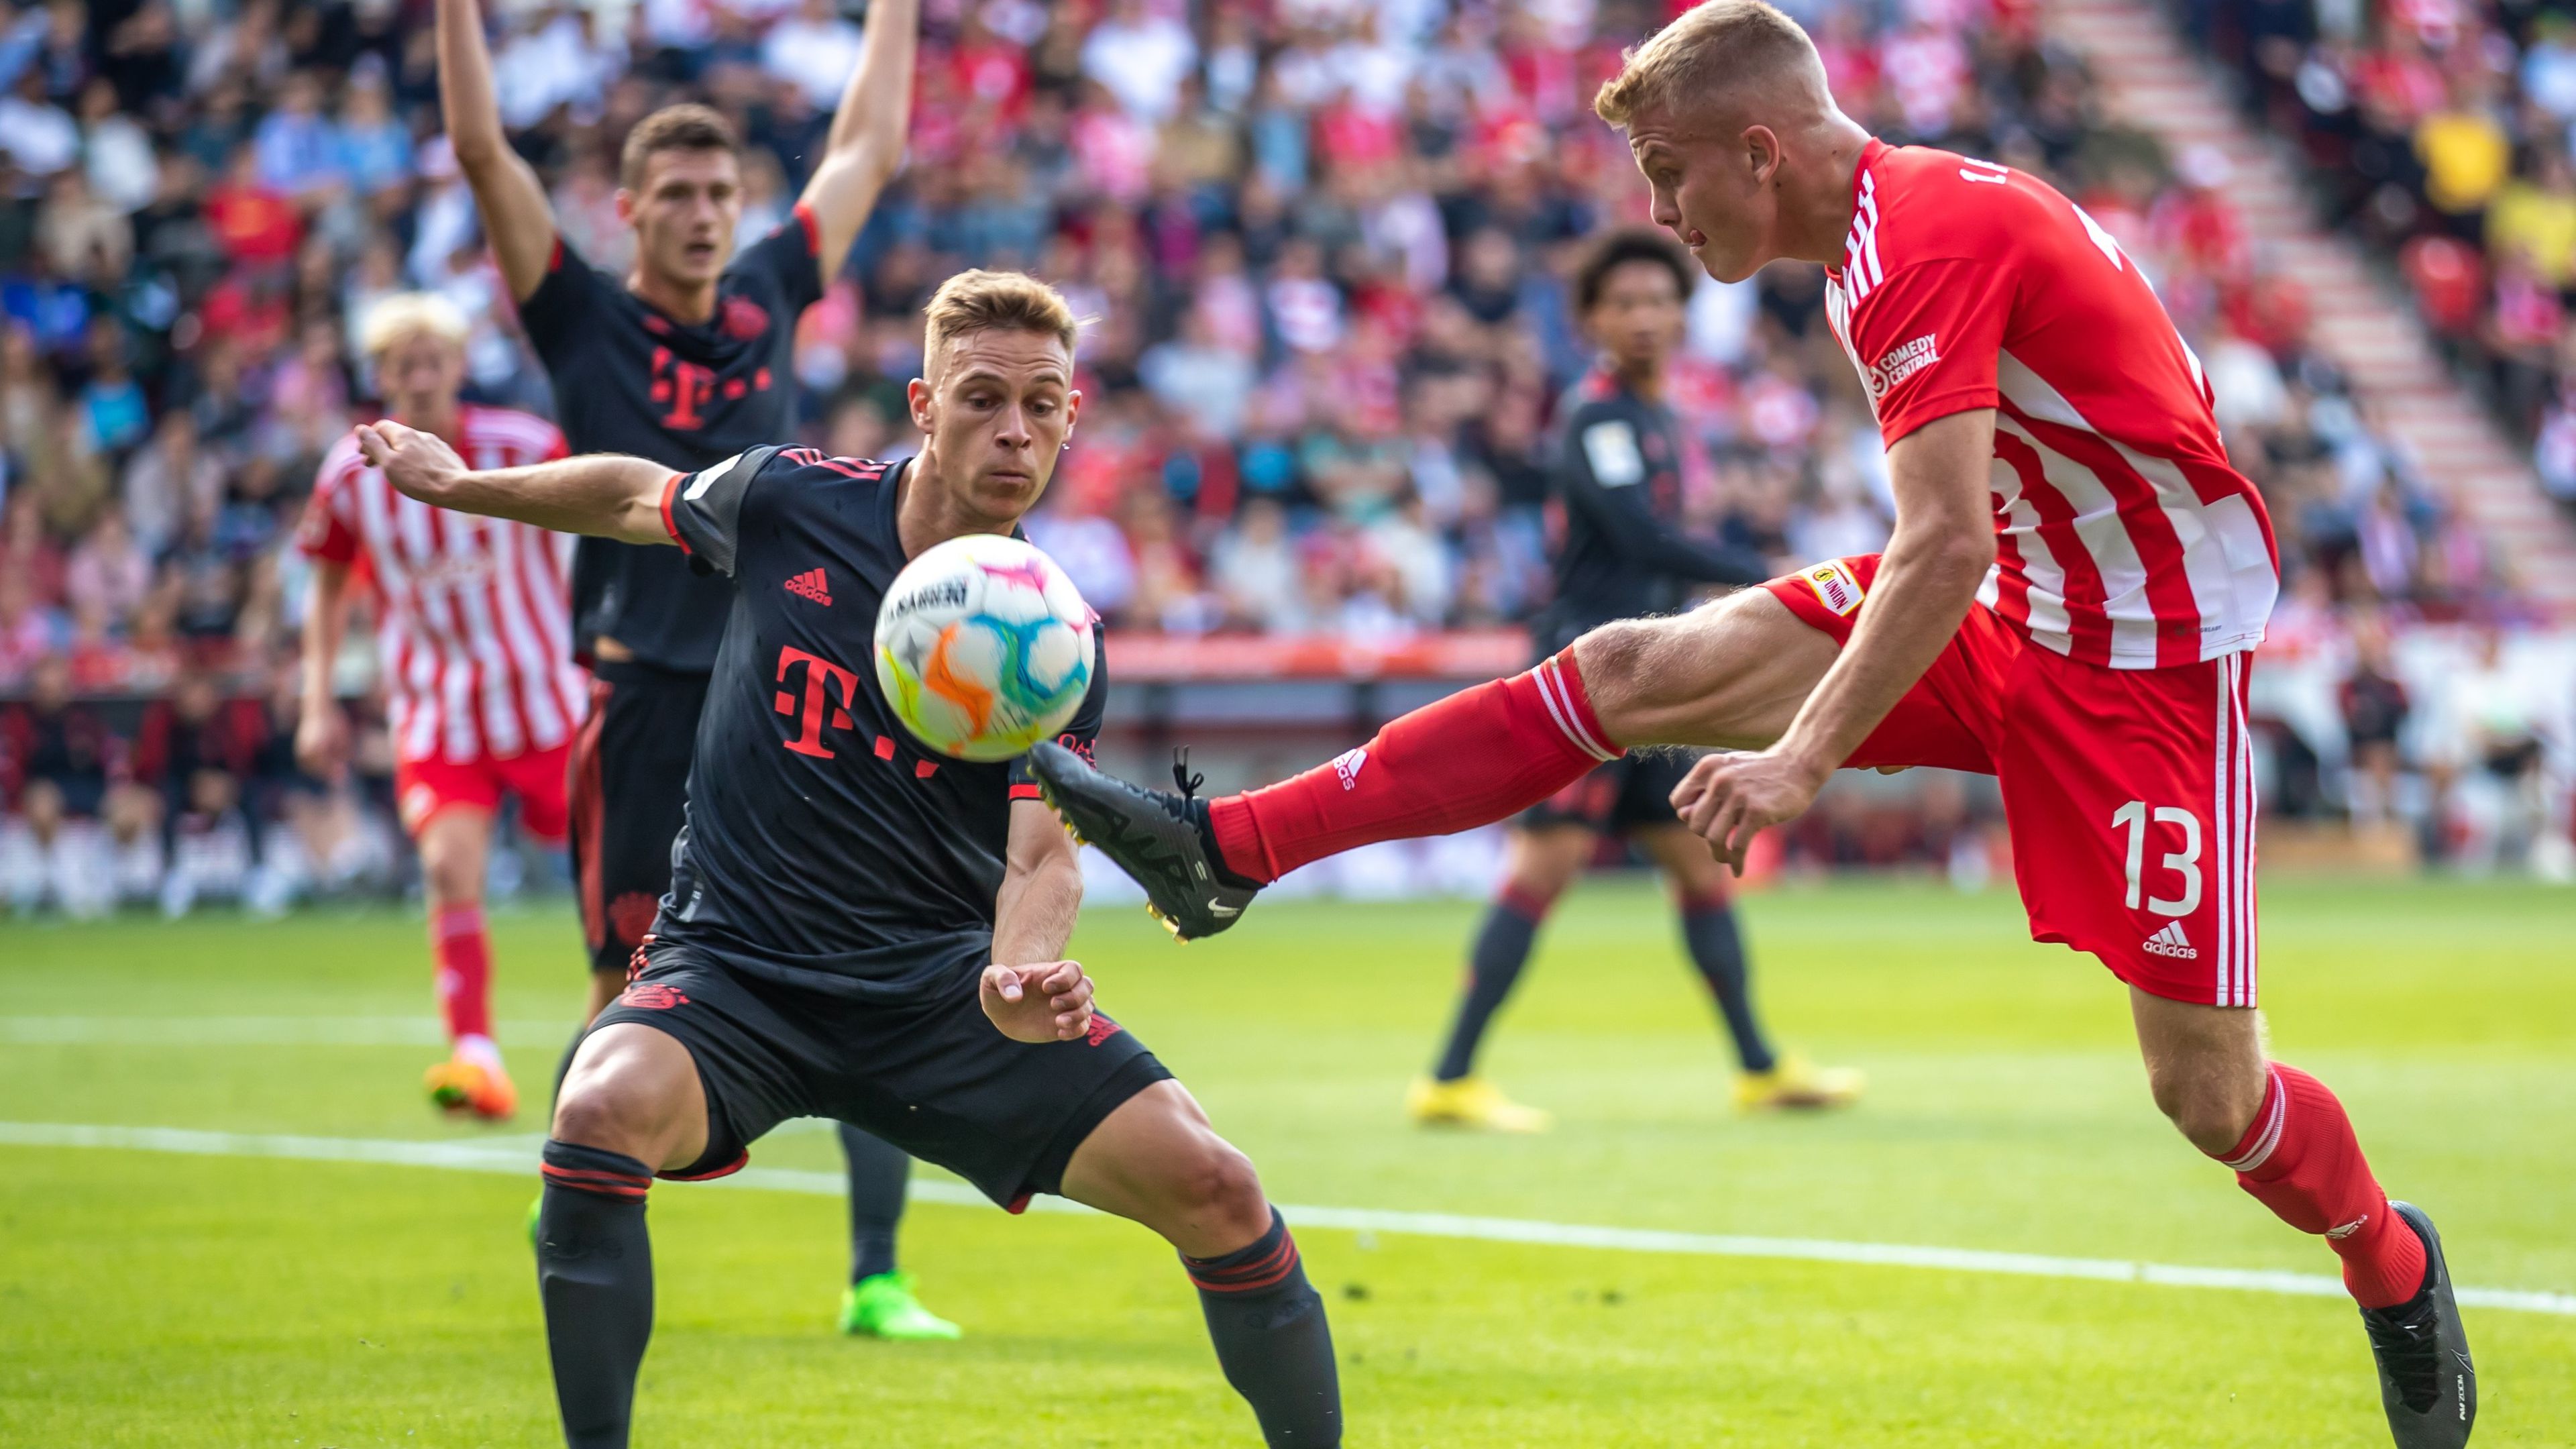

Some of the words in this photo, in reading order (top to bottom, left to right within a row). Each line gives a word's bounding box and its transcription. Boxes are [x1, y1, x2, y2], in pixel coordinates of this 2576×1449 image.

[1879, 333, 1936, 371] COMEDY
[1888, 348, 1941, 386] CENTRAL
[784, 579, 833, 606] adidas
[1825, 578, 1849, 609] UNION
[2111, 800, 2202, 917] 13
[2142, 941, 2198, 959] adidas
[2457, 1374, 2465, 1402] ZOOM
